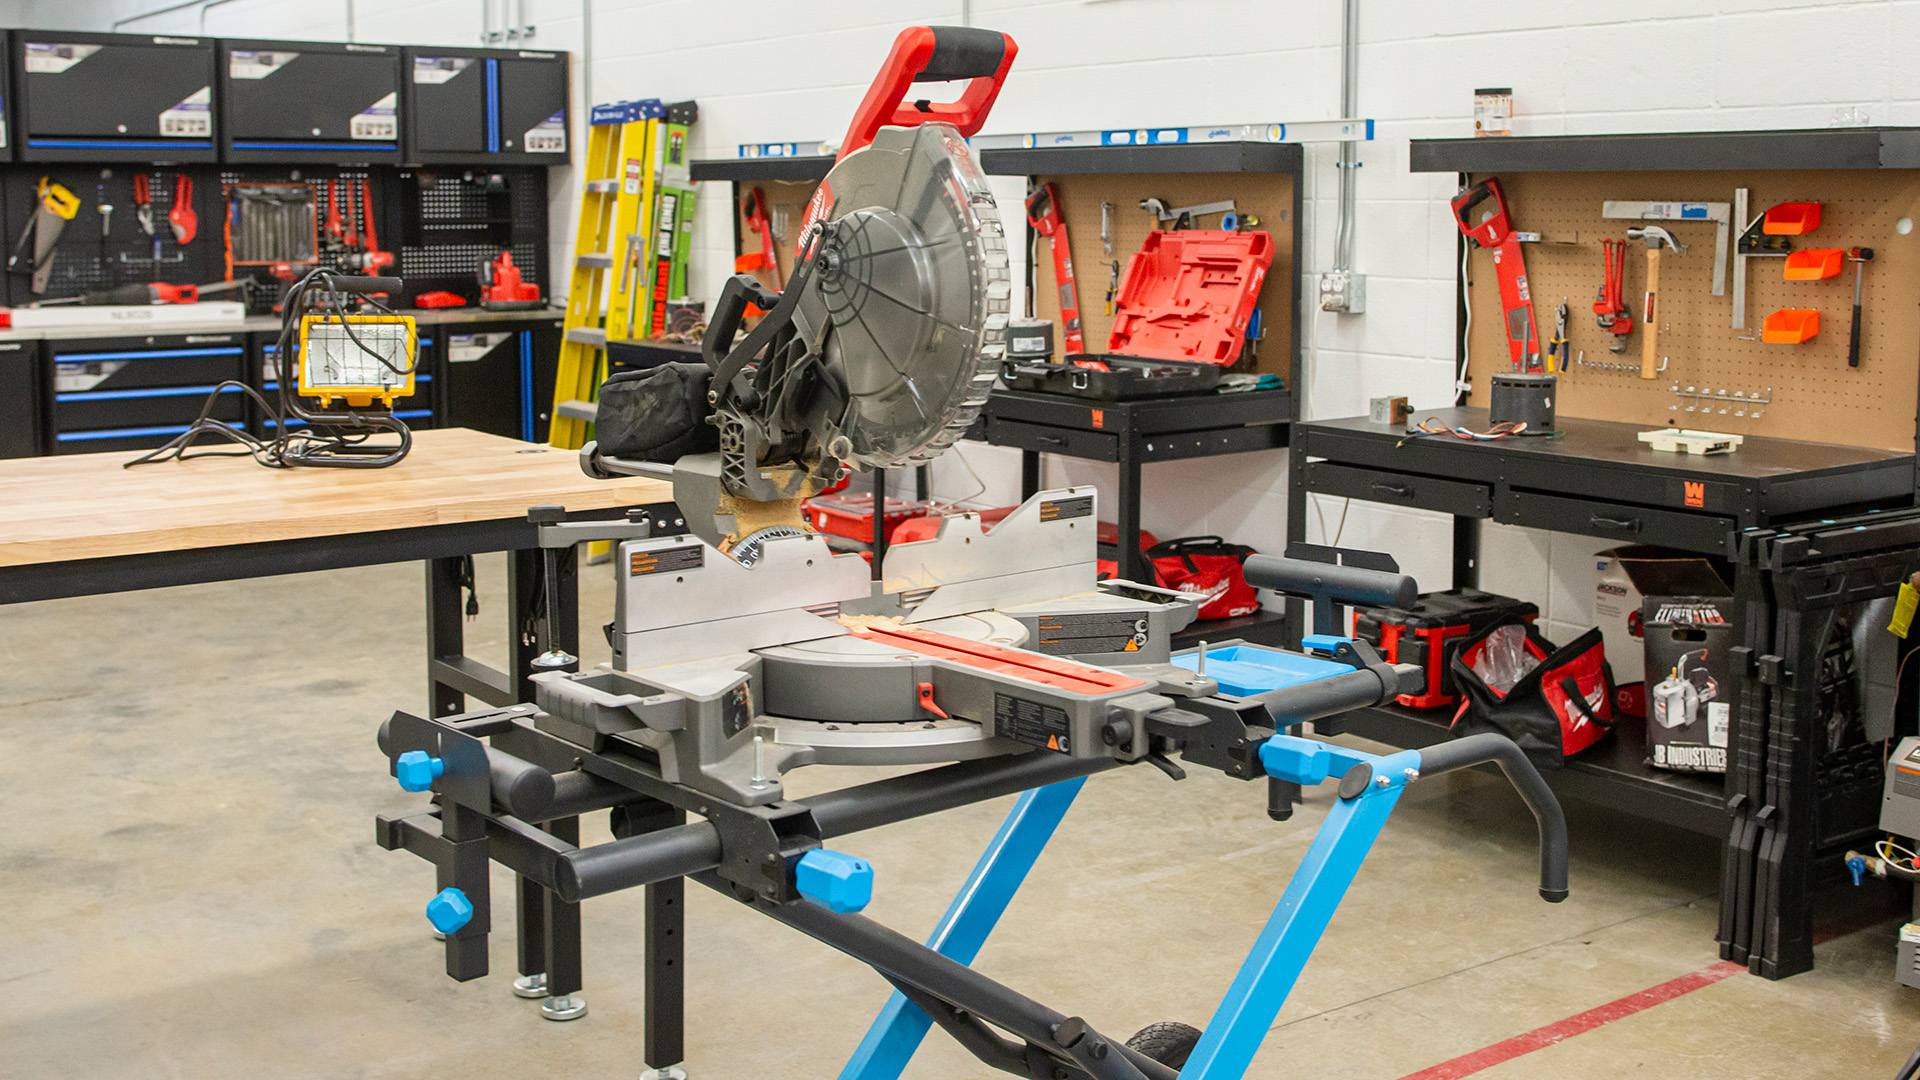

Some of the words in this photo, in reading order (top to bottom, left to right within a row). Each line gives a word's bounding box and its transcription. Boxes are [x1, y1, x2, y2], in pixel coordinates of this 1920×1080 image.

[1598, 582, 1628, 595] JACKSON
[1653, 744, 1666, 764] JB
[1667, 745, 1728, 767] INDUSTRIES
